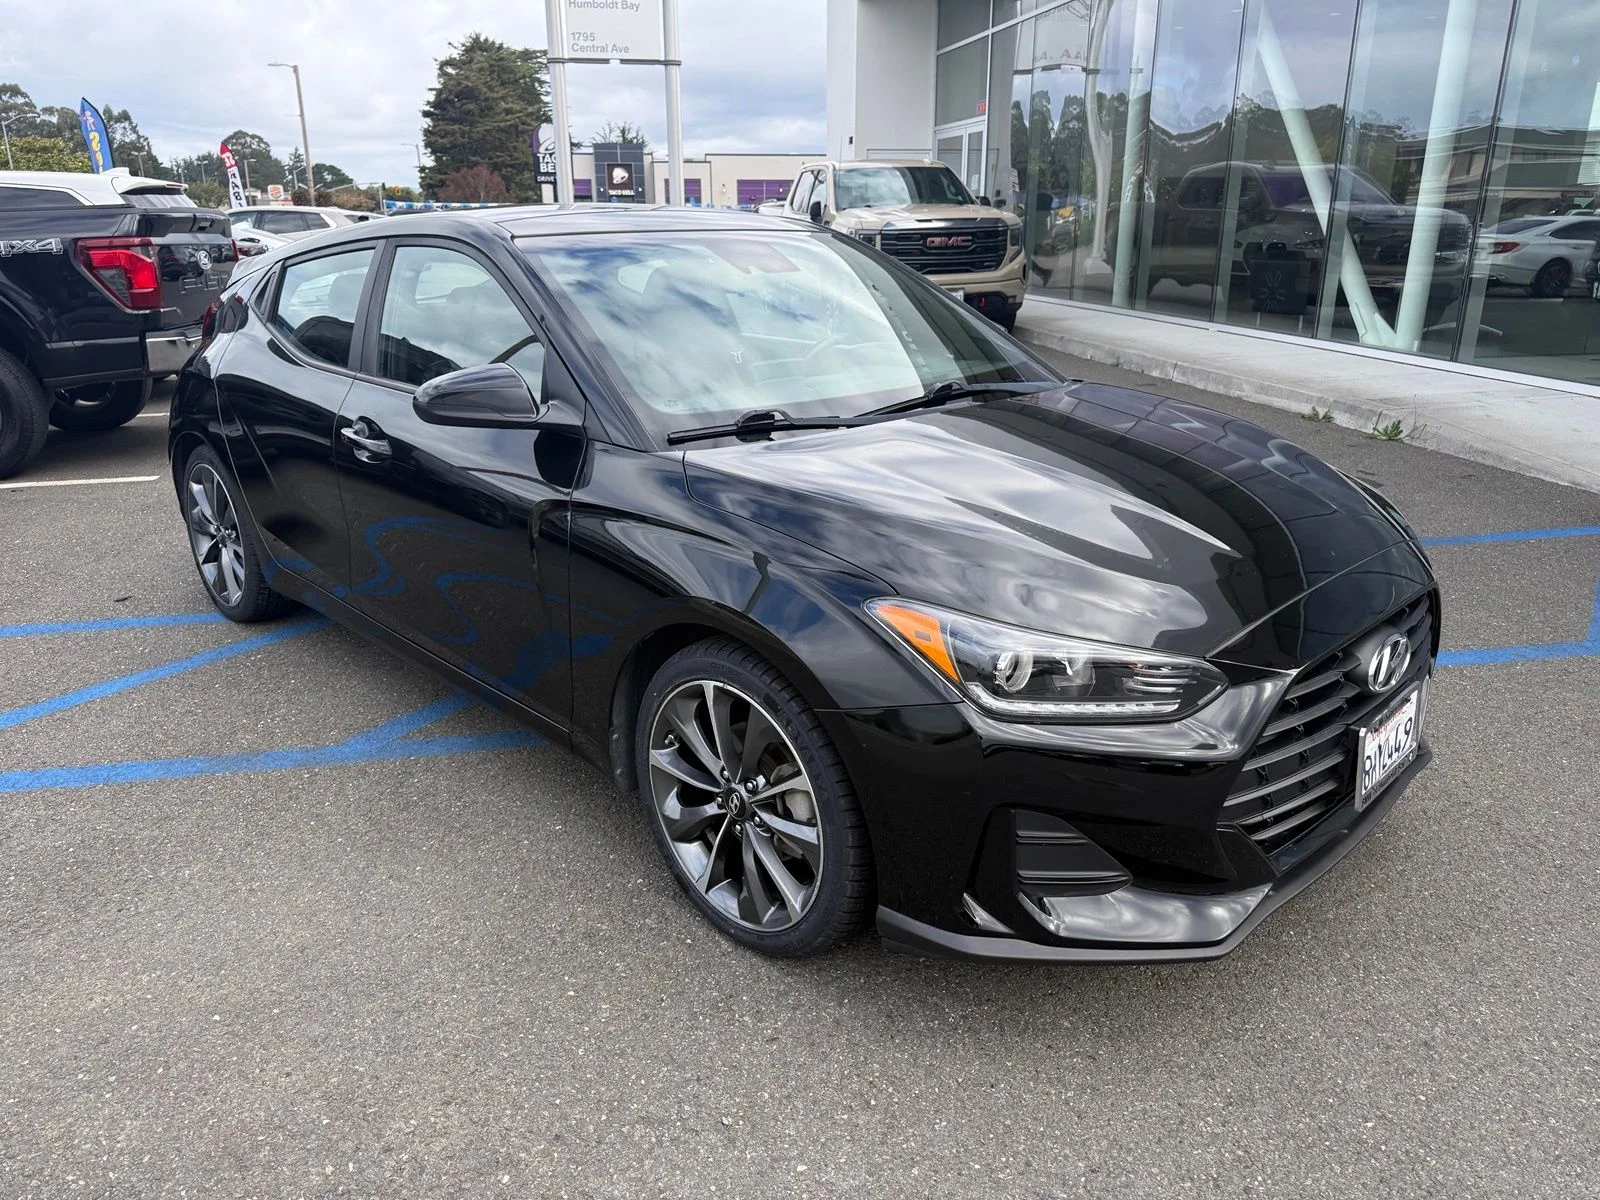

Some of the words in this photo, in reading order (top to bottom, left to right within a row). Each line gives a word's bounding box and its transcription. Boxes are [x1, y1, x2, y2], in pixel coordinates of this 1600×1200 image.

[568, 0, 619, 10] Humboldt
[621, 0, 640, 12] Bay
[571, 32, 596, 42] 1795
[571, 43, 608, 53] Central
[611, 44, 630, 54] Ave
[536, 153, 557, 163] TAC
[539, 163, 555, 173] BE
[926, 236, 973, 248] GMC
